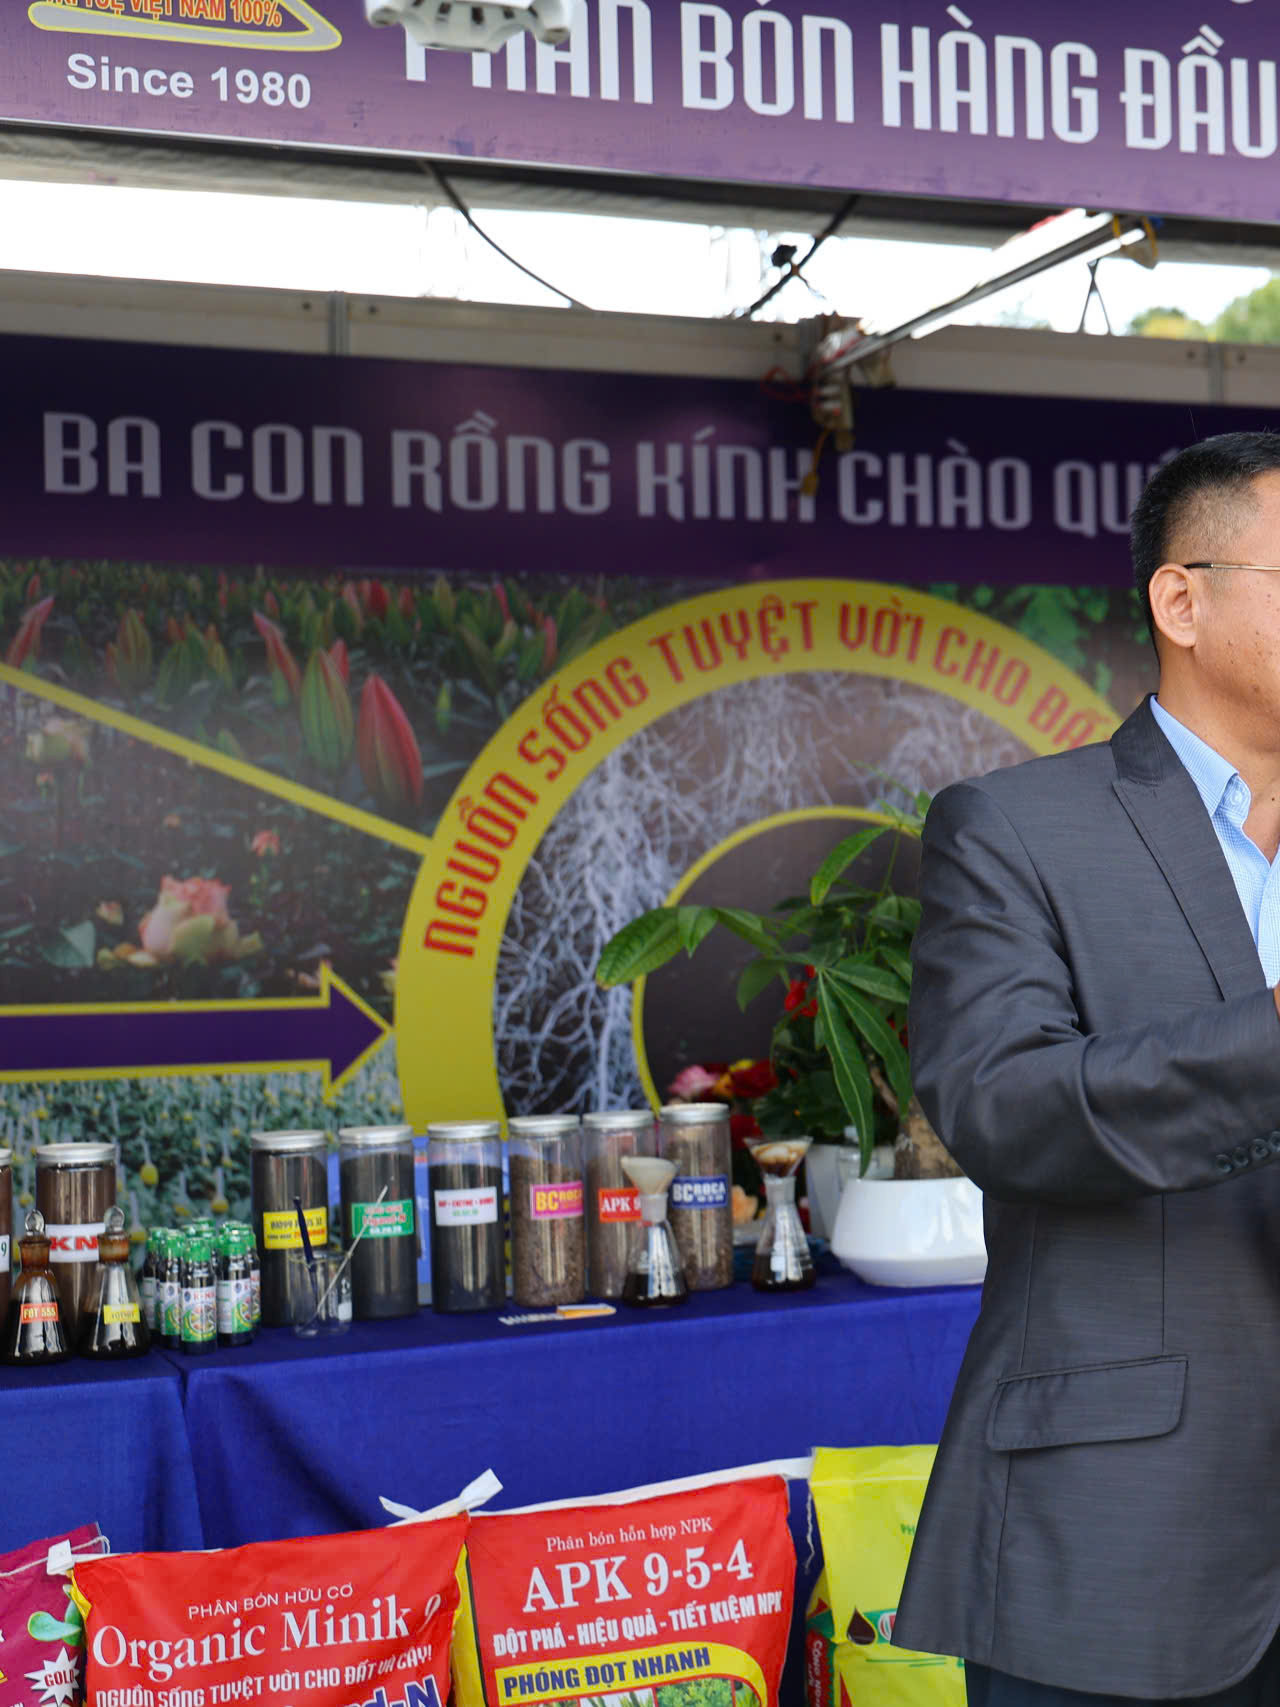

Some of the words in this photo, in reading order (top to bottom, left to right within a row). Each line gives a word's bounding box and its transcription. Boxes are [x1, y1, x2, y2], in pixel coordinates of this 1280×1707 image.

[230, 0, 282, 27] 100%
[67, 52, 194, 98] Since
[210, 66, 311, 109] 1980
[681, 0, 854, 123] BÓN
[881, 5, 1098, 144] HÀNG
[1120, 24, 1278, 158] ĐẦU
[44, 411, 161, 497] BA
[191, 420, 363, 505] CON
[391, 410, 611, 515] RỒNG
[636, 425, 816, 522] KÍNH
[838, 437, 1031, 531] CHÀO
[423, 771, 540, 959] NGUỒN
[517, 655, 650, 783] SỐNG
[646, 593, 819, 685] TUYỆT
[838, 595, 925, 664] VỜI
[931, 626, 1032, 708] CHO
[1027, 683, 1115, 749] ĐẤ
[535, 1190, 559, 1211] BC
[601, 1196, 631, 1212] APK
[672, 1183, 694, 1203] BC
[546, 1536, 584, 1552] Phân
[589, 1532, 615, 1546] bón
[650, 1523, 677, 1540] hợp
[680, 1517, 713, 1535] NPK
[522, 1555, 632, 1613] APK
[643, 1538, 754, 1597] 9-5-4
[188, 1600, 238, 1620] PHÂN
[243, 1592, 278, 1611] BÓN
[285, 1587, 321, 1604] HỮU
[327, 1582, 354, 1599] CƠ
[493, 1627, 527, 1659] ĐỘT
[530, 1622, 566, 1651] PHÁ
[576, 1617, 619, 1647] HIỆU
[621, 1608, 658, 1639] QUẢ
[668, 1600, 709, 1631] TIẾT
[710, 1595, 756, 1625] KIỆM
[757, 1591, 783, 1615] NPK
[92, 1618, 266, 1683] Organic
[281, 1593, 412, 1652] Minik
[44, 1669, 75, 1687] GOLD
[95, 1683, 154, 1707] NGUỒN
[157, 1686, 205, 1707] SỐNG
[209, 1675, 264, 1704] TUYỆT
[269, 1668, 300, 1692] VỜI
[304, 1667, 340, 1689] CHO
[344, 1658, 377, 1685] ĐẤT
[504, 1666, 579, 1697] PHÓNG
[585, 1662, 626, 1688] ĐỌT
[633, 1647, 711, 1678] NHANH
